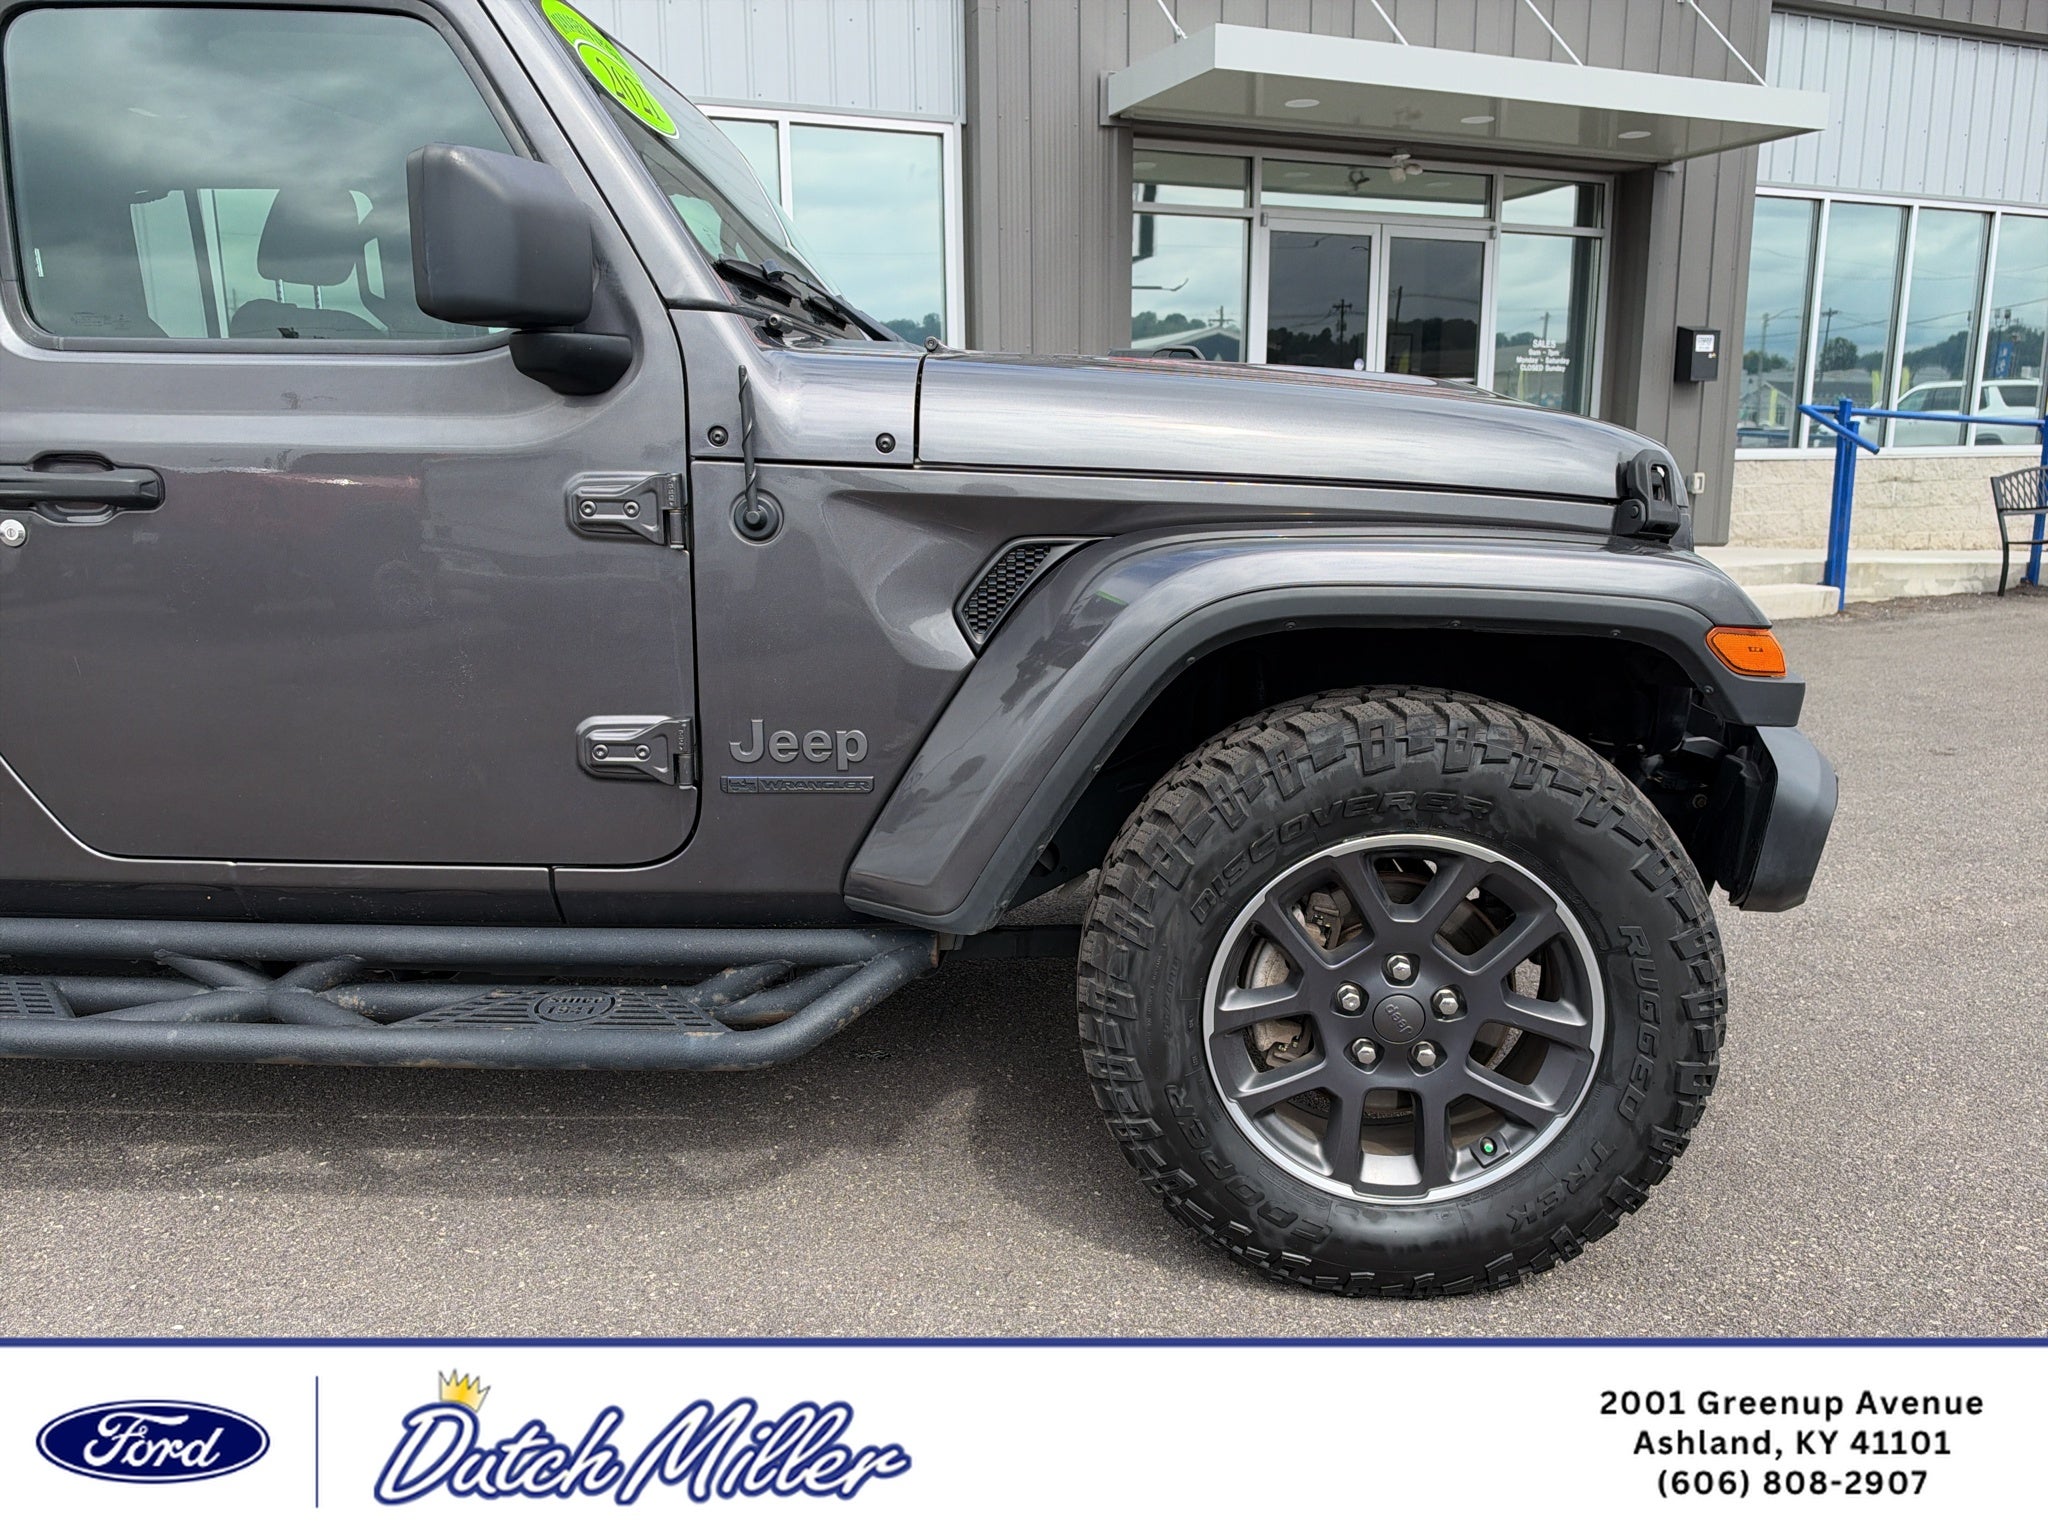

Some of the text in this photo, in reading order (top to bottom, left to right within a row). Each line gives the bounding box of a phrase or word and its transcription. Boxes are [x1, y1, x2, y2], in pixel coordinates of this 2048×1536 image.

[1516, 356, 1539, 364] Monday
[1545, 357, 1570, 366] Saturday
[1520, 364, 1566, 373] CLOSED Sunday
[1532, 339, 1556, 348] SALES
[729, 719, 868, 772] Jeep
[1190, 789, 1498, 926] DISCOVERER
[1385, 1003, 1413, 1034] Jeep
[1614, 923, 1664, 1124] RUGGED
[1163, 1083, 1334, 1246] COOPER
[1505, 1139, 1619, 1236] TREK
